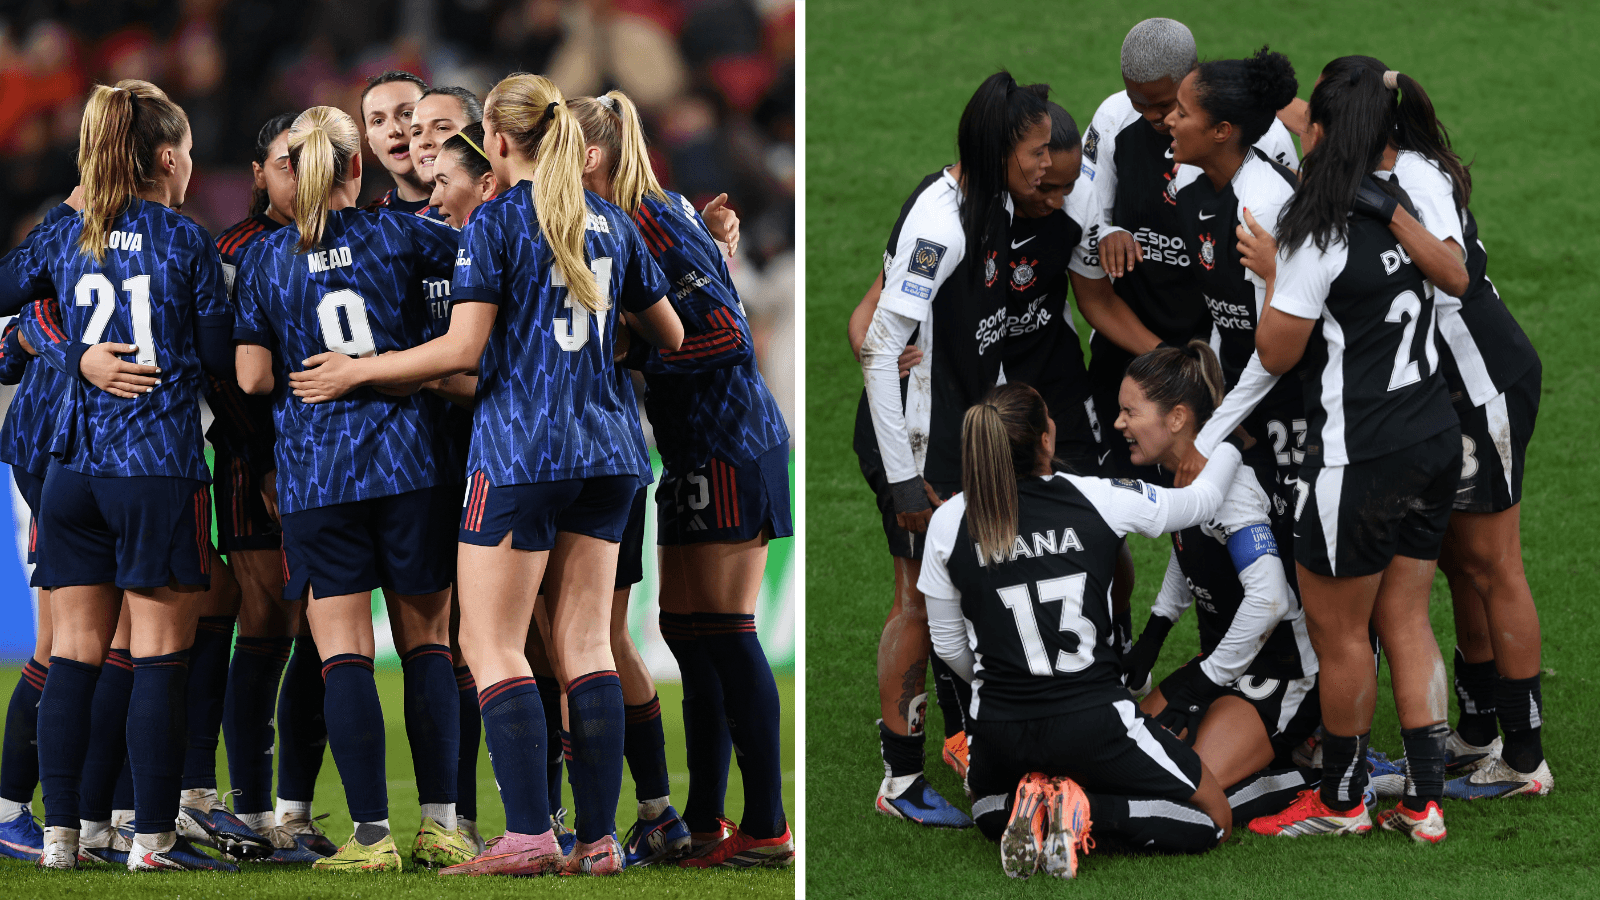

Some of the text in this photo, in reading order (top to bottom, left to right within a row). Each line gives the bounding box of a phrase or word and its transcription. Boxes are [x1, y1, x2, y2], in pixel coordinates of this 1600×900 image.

[307, 246, 353, 274] MEAD
[74, 272, 158, 367] 21
[974, 527, 1085, 568] IVANA
[996, 571, 1097, 678] 13
